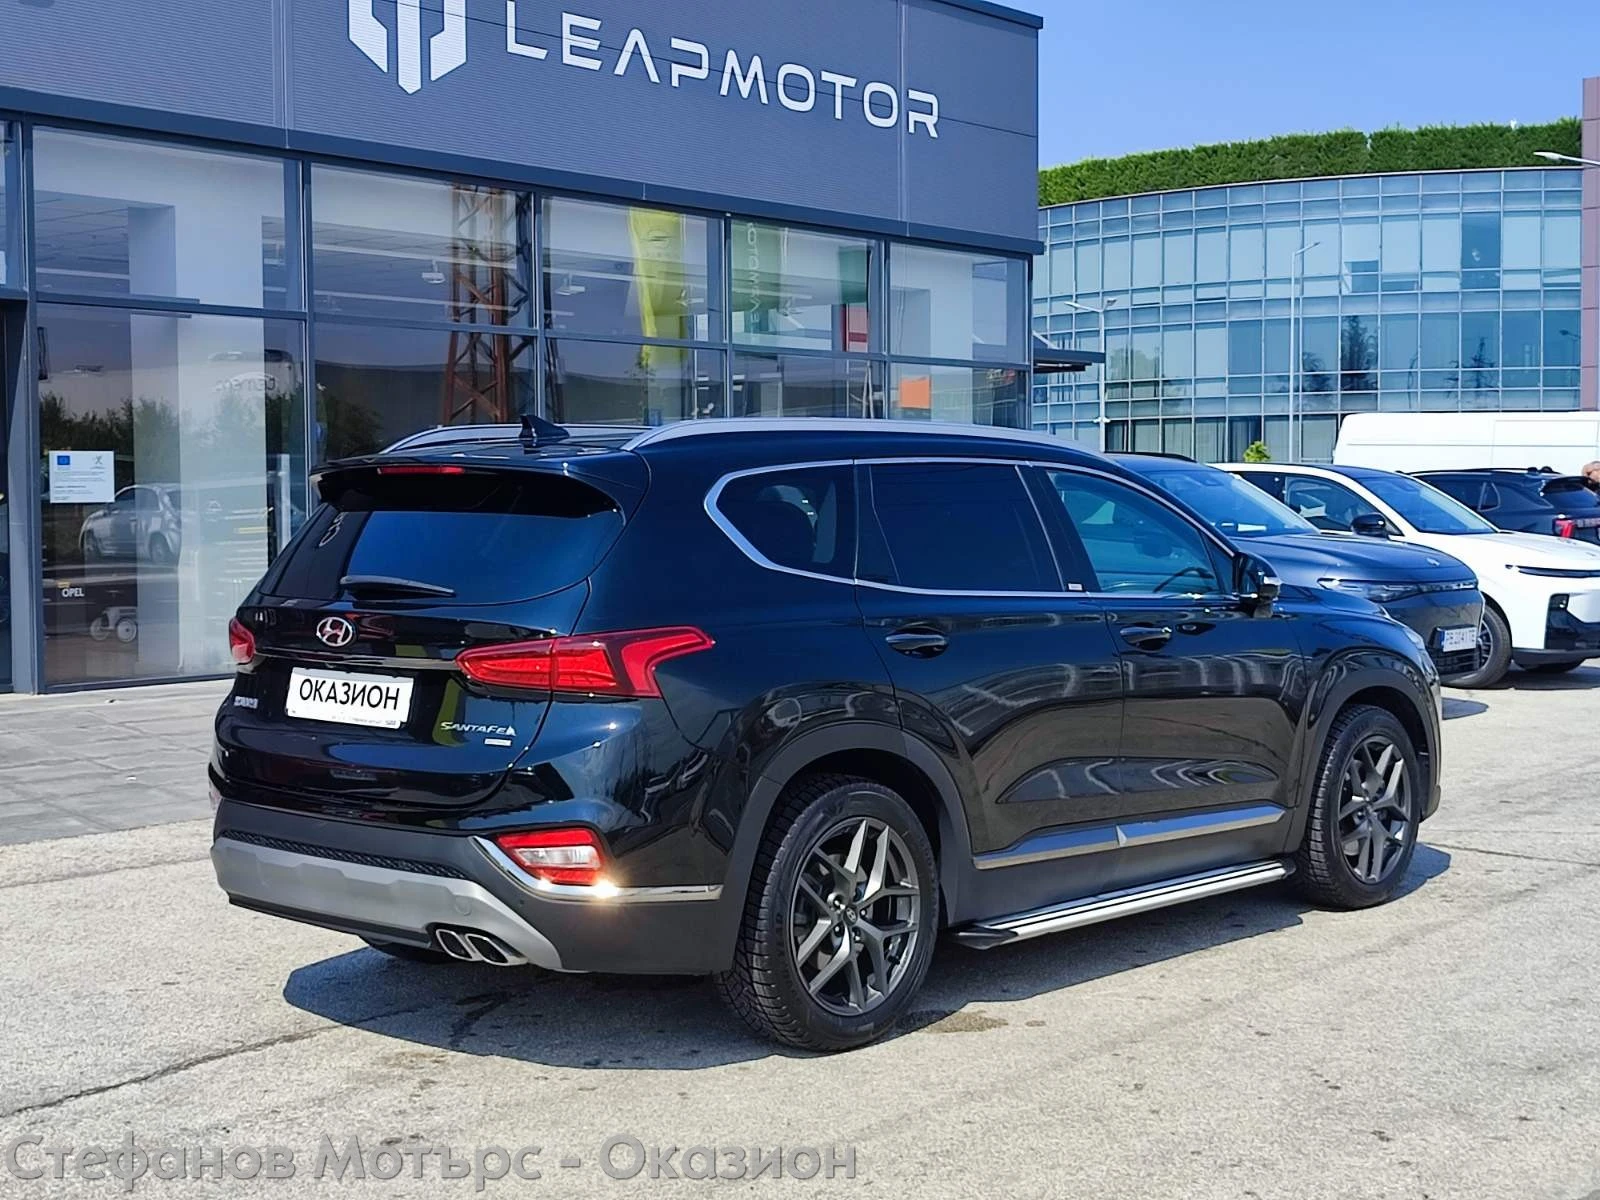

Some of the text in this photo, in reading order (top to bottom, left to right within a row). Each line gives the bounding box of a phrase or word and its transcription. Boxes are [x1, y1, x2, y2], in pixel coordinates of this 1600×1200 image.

[506, 0, 939, 139] LEAPMOTOR
[61, 587, 85, 598] OPEL
[299, 678, 400, 711] ОКАЗИОН
